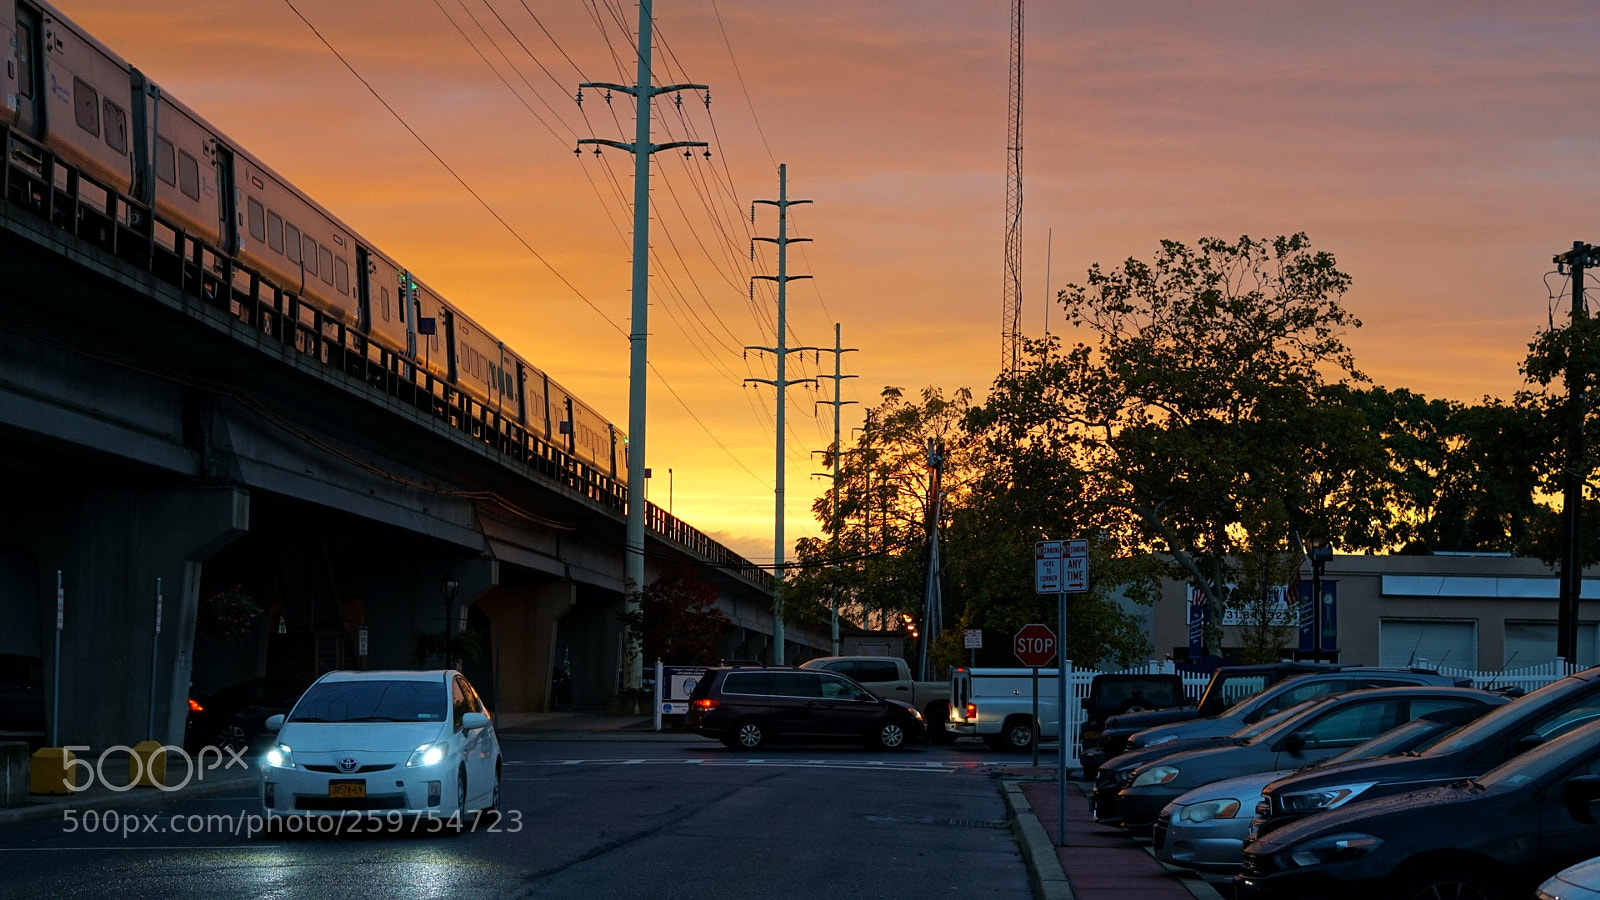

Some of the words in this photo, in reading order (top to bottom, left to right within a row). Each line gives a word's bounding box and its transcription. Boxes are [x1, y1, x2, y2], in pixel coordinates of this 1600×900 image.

[1068, 559, 1082, 569] ANY
[1067, 570, 1084, 581] TIME
[1017, 637, 1054, 653] STOP
